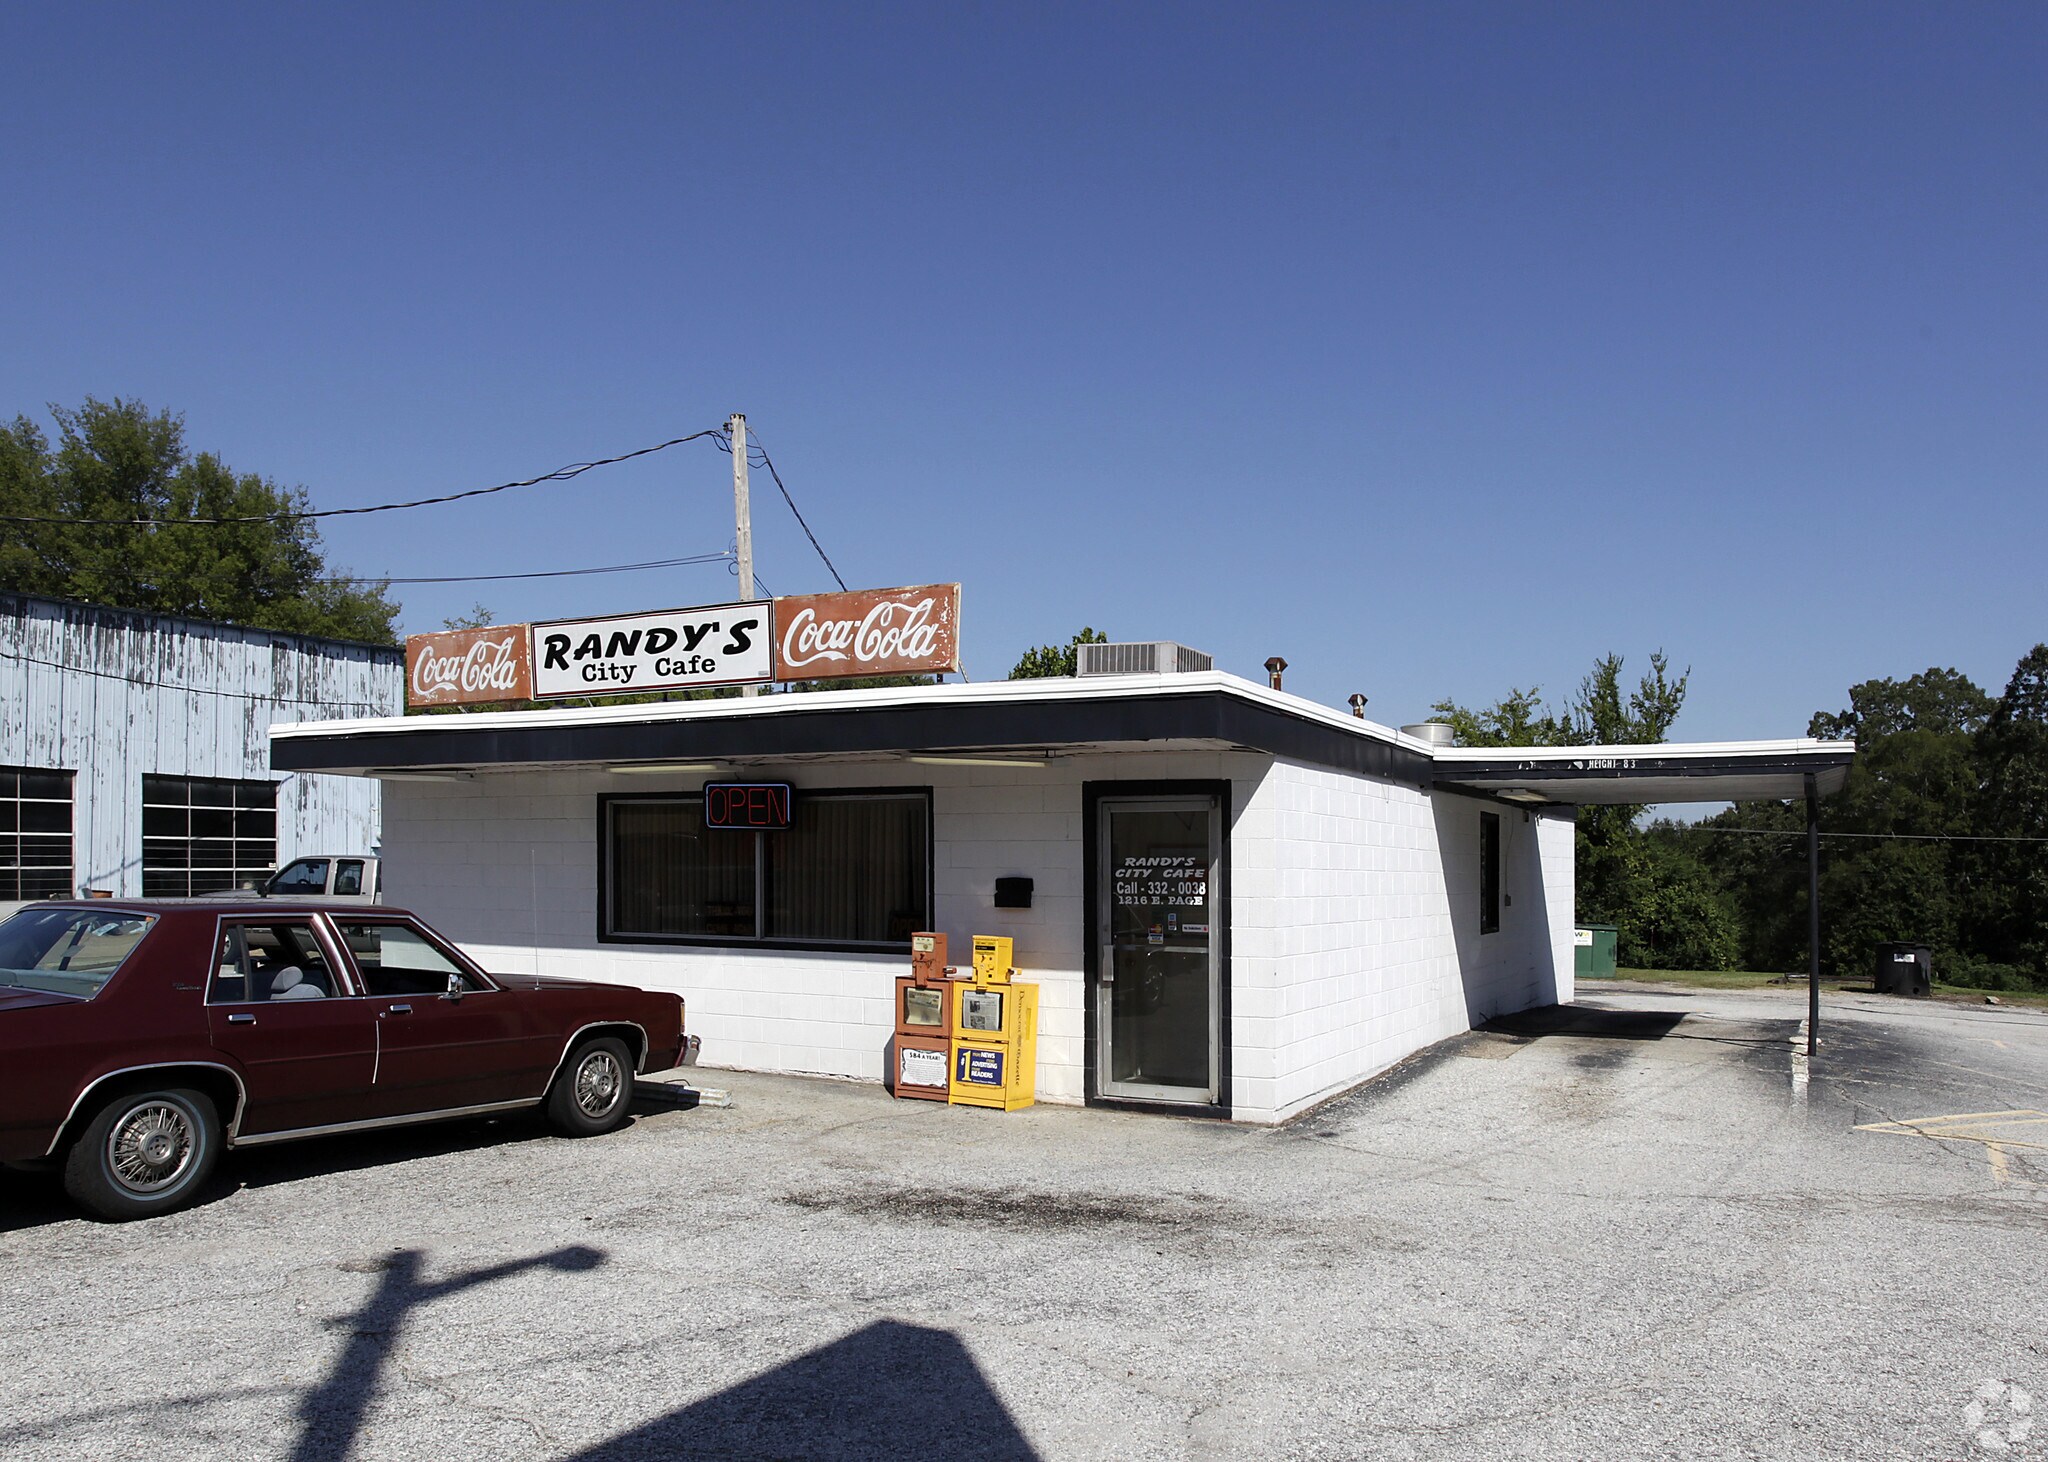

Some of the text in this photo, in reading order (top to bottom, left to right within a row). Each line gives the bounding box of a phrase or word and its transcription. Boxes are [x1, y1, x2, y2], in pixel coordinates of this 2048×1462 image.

[544, 619, 759, 671] RANDY'S
[782, 597, 940, 667] Coca-Cola
[412, 634, 518, 696] Coca-Cola
[581, 654, 717, 684] City Cafe
[709, 788, 787, 825] OPEN
[1115, 868, 1206, 878] CITY CAFE
[1124, 857, 1196, 867] RANDY'S
[1116, 881, 1138, 895] Call
[1147, 881, 1169, 895] 332
[1178, 881, 1206, 895] 0038
[1118, 896, 1204, 906] 1216 E. PAGE
